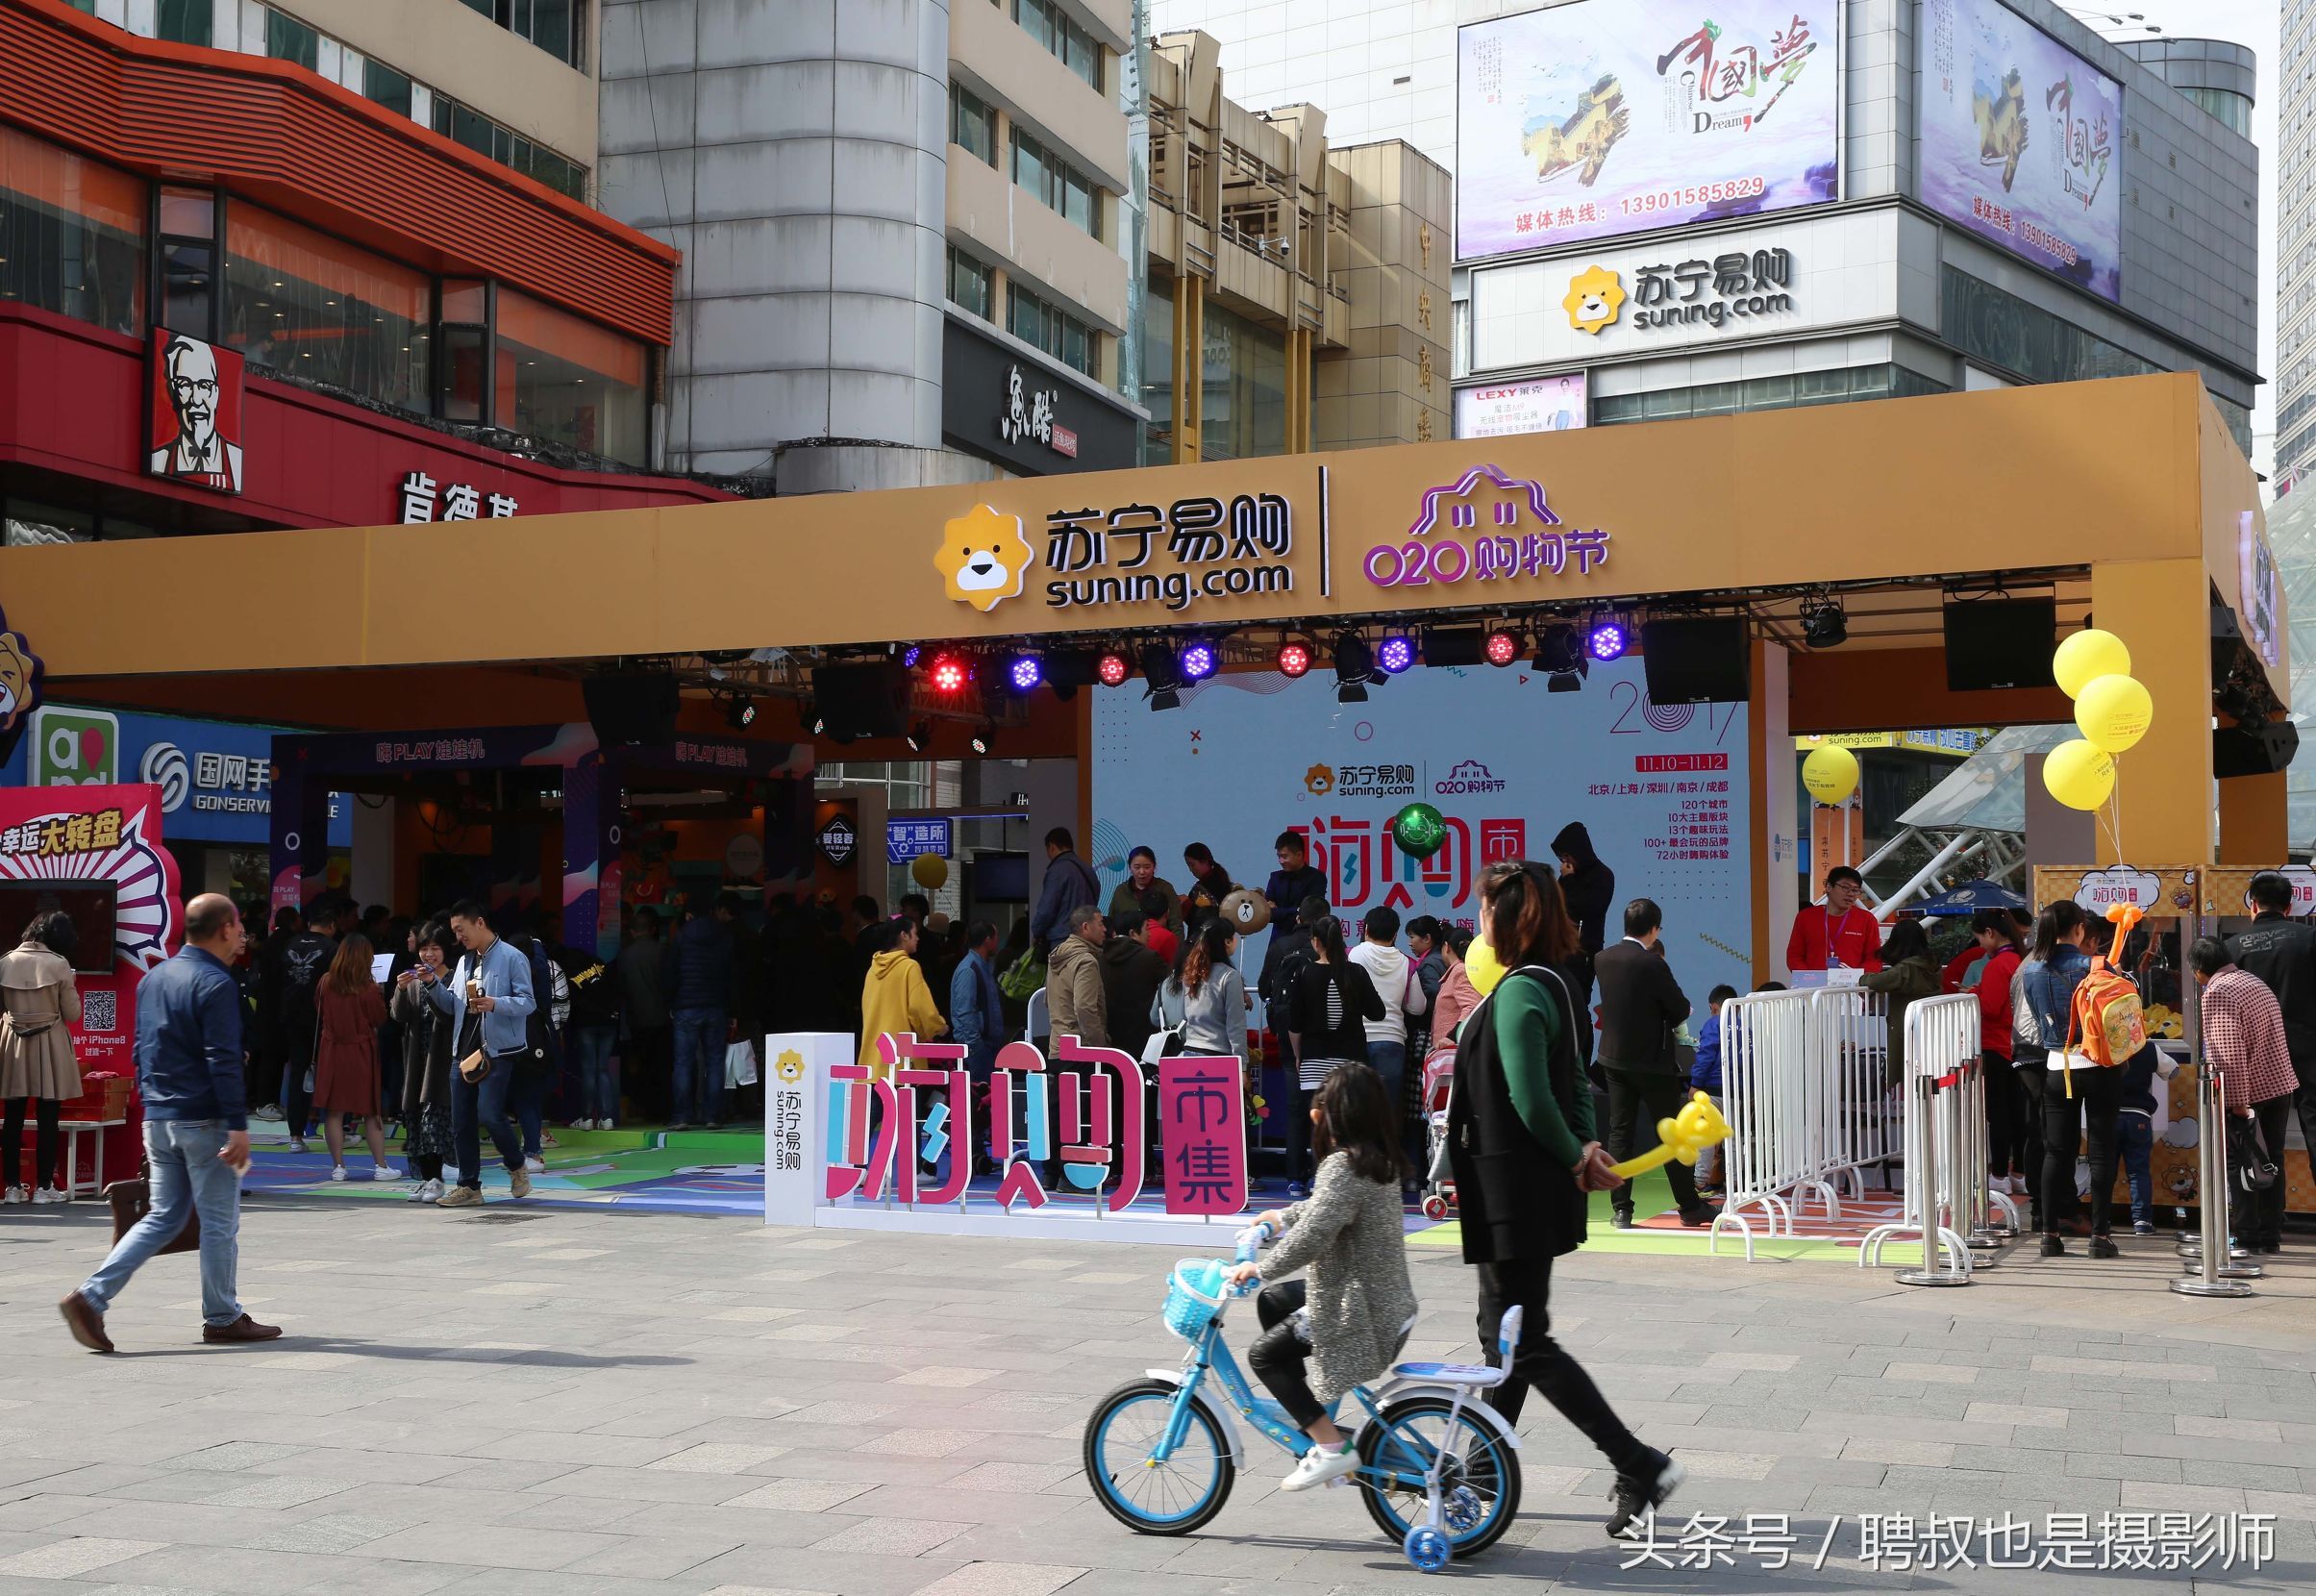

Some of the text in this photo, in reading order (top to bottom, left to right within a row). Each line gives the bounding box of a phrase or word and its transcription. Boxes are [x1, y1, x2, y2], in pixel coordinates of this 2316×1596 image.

[1680, 70, 1696, 112] Chinese
[1621, 176, 1764, 215] 13901585829
[2021, 221, 2077, 266] 13901585829
[1634, 246, 1791, 308] 苏宁易购
[1633, 291, 1791, 329] suning.com
[1477, 388, 1517, 400] LEXY
[1046, 492, 1292, 572] 苏宁易购
[1046, 561, 1292, 611] suning.com
[1829, 736, 1881, 746] suning.com
[1339, 764, 1414, 785] 苏宁易购
[1339, 785, 1414, 798] suning.com
[1681, 800, 1728, 810] 120个城市
[1, 810, 121, 856] 幸运大转盘
[88, 1035, 126, 1044] iPhone8
[774, 1090, 784, 1170] suning.com
[785, 1091, 801, 1171] 苏宁易购
[1175, 1069, 1234, 1205] 市集
